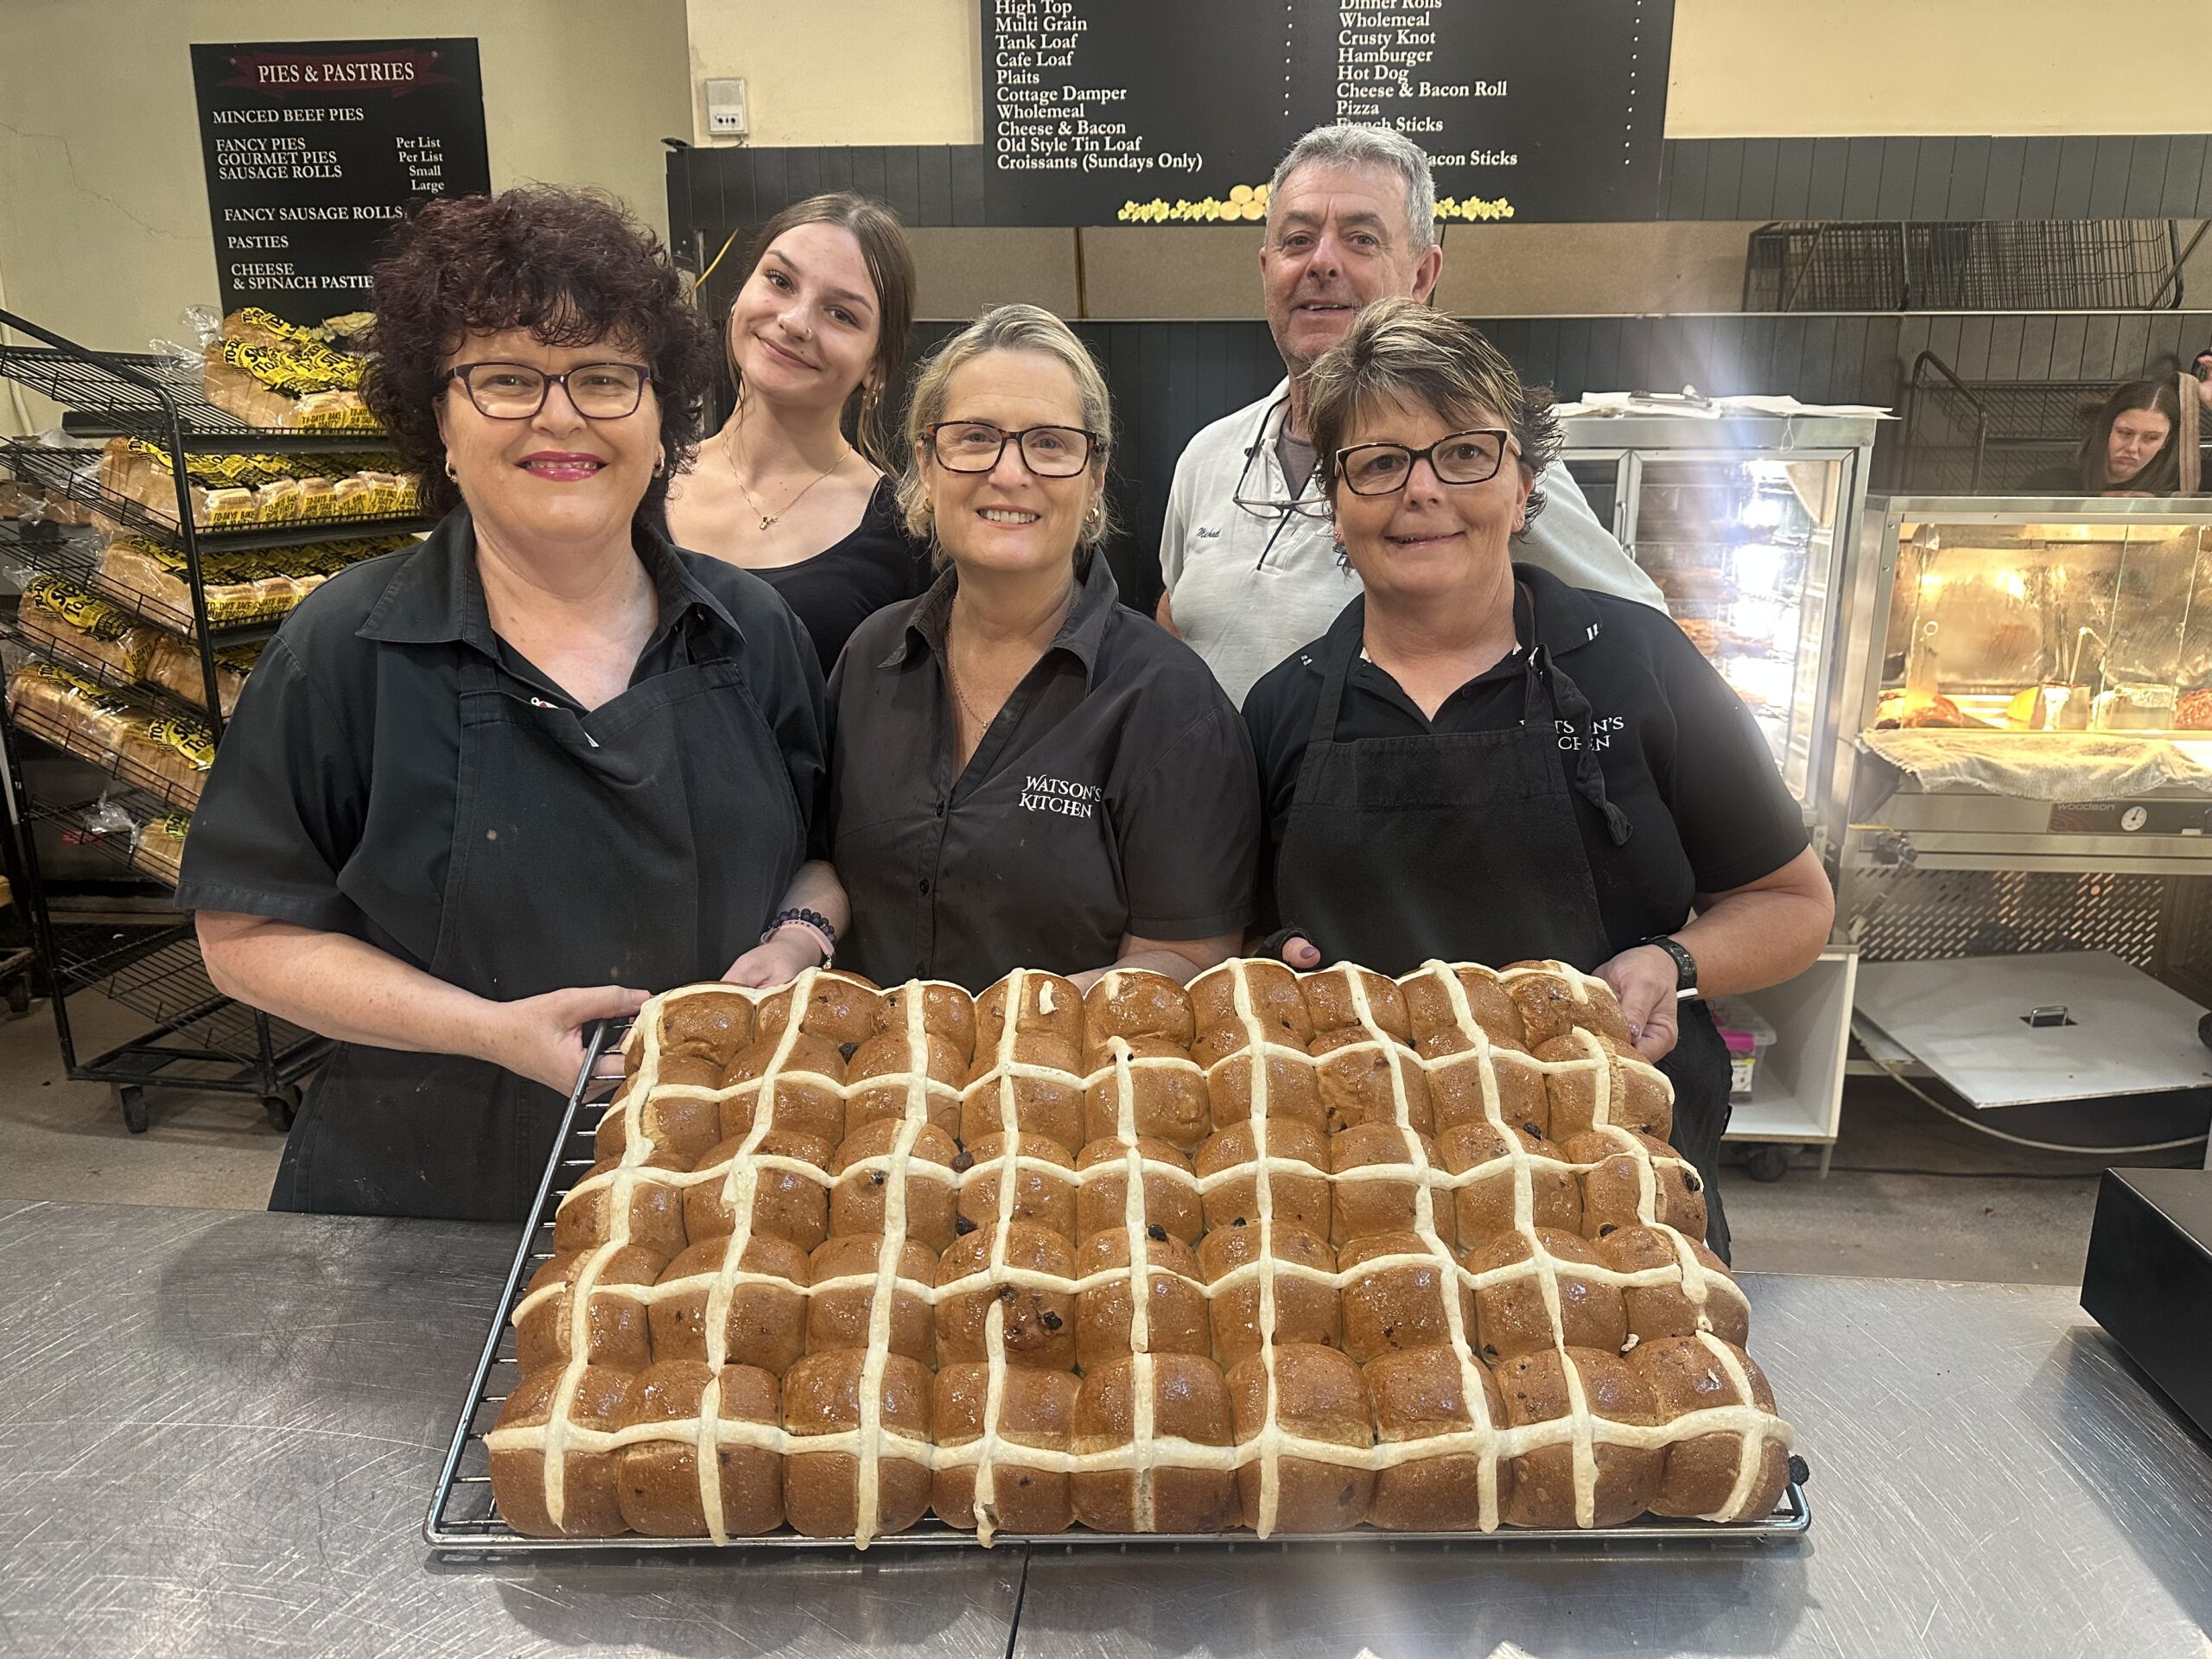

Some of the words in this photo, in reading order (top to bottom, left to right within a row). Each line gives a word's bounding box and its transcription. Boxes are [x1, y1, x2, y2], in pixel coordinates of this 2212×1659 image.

[995, 0, 1037, 18] High
[1039, 0, 1072, 18] Top
[995, 16, 1039, 32] Multi
[1043, 15, 1088, 32] Grain
[1338, 10, 1430, 29] Wholemeal
[995, 34, 1037, 50] Tank
[1039, 33, 1079, 49] Loaf
[1338, 29, 1393, 50] Crusty
[1395, 29, 1437, 45] Knot
[995, 51, 1032, 67] Cafe
[1036, 50, 1075, 67] Loaf
[1338, 48, 1433, 67] Hamburger
[257, 64, 300, 83] PIES
[304, 65, 319, 82] &
[322, 61, 416, 82] PASTRIES
[996, 69, 1040, 85] Plaits
[1337, 65, 1370, 81] Hot
[1373, 64, 1410, 84] Dog
[996, 87, 1058, 105] Cottage
[1062, 85, 1128, 105] Damper
[1336, 82, 1395, 99] Cheese
[1399, 82, 1414, 98] &
[1418, 81, 1470, 98] Bacon
[1474, 80, 1507, 97] Roll
[213, 110, 279, 124] MINCED
[283, 108, 325, 122] BEEF
[328, 107, 365, 121] PIES
[996, 103, 1085, 119] Wholemeal
[1336, 99, 1380, 116] Pizza
[997, 120, 1053, 137] Cheese
[1058, 120, 1072, 136] &
[1077, 119, 1127, 135] Bacon
[1395, 115, 1445, 131] Sticks
[216, 138, 267, 152] FANCY
[271, 137, 306, 150] PIES
[396, 137, 415, 149] Per
[417, 135, 442, 148] List
[996, 137, 1027, 153] Old
[1030, 137, 1068, 156] Style
[1071, 136, 1100, 152] Tin
[1103, 136, 1143, 151] Loaf
[217, 151, 298, 166] GOURMET
[302, 150, 337, 164] PIES
[398, 150, 417, 162] Per
[420, 149, 443, 162] List
[997, 153, 1078, 169] Croissants
[1082, 153, 1154, 173] (Sundays
[1158, 152, 1204, 173] Only)
[1426, 152, 1466, 166] acon
[1470, 149, 1518, 166] Sticks
[219, 166, 289, 180] SAUSAGE
[292, 164, 342, 178] ROLLS
[409, 165, 442, 177] Small
[411, 179, 445, 194] Large
[224, 208, 276, 222] FANCY
[279, 207, 349, 220] SAUSAGE
[353, 206, 404, 219] ROLLS
[227, 235, 289, 249] PASTIES
[231, 263, 295, 276] CHEESE
[232, 277, 245, 290] &
[248, 276, 318, 289] SPINACH
[321, 275, 374, 289] PASTIE
[1021, 774, 1103, 802] WATSON'S
[1019, 792, 1093, 819] KITCHEN
[2057, 803, 2115, 811] woodson
